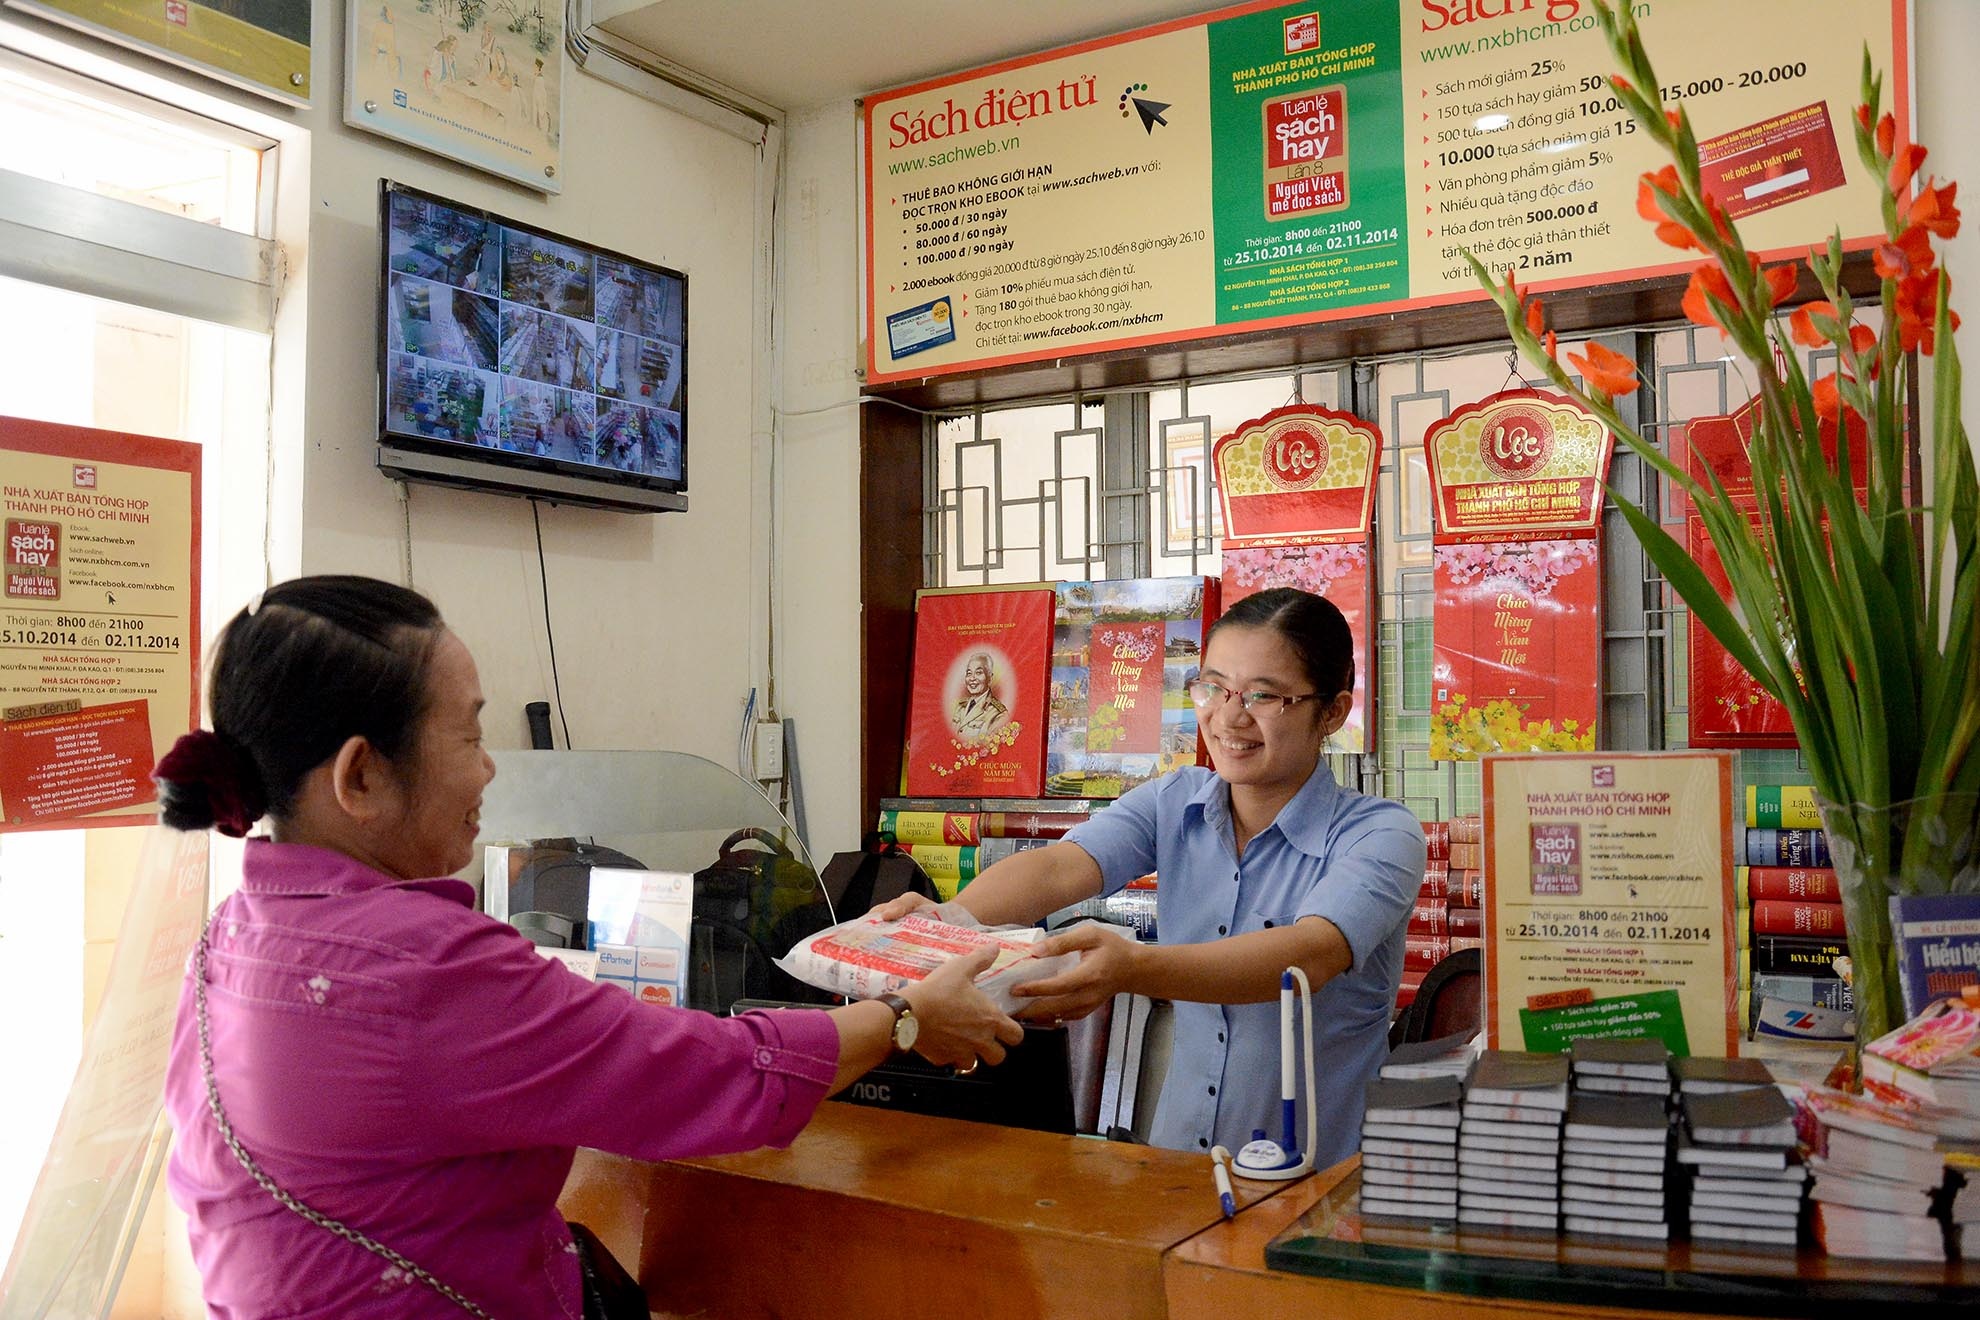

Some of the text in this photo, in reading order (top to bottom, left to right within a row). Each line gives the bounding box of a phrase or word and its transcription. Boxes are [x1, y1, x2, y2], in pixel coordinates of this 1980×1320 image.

[1420, 3, 1651, 64] www.nxbhcm.con
[1233, 42, 1376, 81] NHÀ XUẤT BẢN TỔNG HỢP
[1234, 56, 1375, 94] THÀNH PHỐ HỒ CHÍ MINH
[1436, 61, 1566, 96] Sách mới giảm 25%
[1659, 62, 1807, 102] 15.000 20.000
[889, 74, 1098, 150] Sách điện tử
[1276, 110, 1335, 141] sách
[888, 137, 1019, 175] www.sachweb.vn
[1282, 138, 1329, 160] hay
[1439, 152, 1613, 191] Văn phòng phẩm giảm 5%
[902, 164, 1052, 204] THUÊ BAO KHÔNG GIỚI HẠN
[902, 160, 1161, 221] ĐỌC TRỌN KHO EBOOK tại www.sachweb.vn với:
[1275, 176, 1337, 201] Người Việt
[1272, 189, 1342, 213] mê đọc sách
[1440, 179, 1593, 213] Nhiều quà tặng độc đáo
[1441, 201, 1598, 236] Hóa đơn trên 500.000 đ
[1245, 220, 1362, 248] Thời gian: 8h00 đến 21h00
[1223, 228, 1398, 266] từ 25.10.2014 đến 02.11.2014
[975, 263, 1135, 299] Giảm 10% phiếu mua sách điện tử.
[976, 313, 1163, 348] Chi tiết tại: www.facebook.com/nxbhcm
[1495, 427, 1540, 463] Lộc
[1276, 441, 1317, 475] Lộc
[4, 486, 149, 511] NHÀ XUẤT BẢN TỔNG HỢP
[1478, 484, 1504, 498] XUẤT
[1529, 483, 1557, 495] TỔNG
[1559, 482, 1580, 495] HỢP
[4, 500, 149, 523] THÀNH PHỐ HỒ CHÍ MINH
[1457, 501, 1490, 513] THÀNH
[1491, 499, 1514, 512] PHỐ
[1551, 496, 1581, 510] MINH
[12, 534, 54, 551] sách
[69, 534, 135, 545] www.sachweb.vn
[15, 549, 49, 567] hay
[69, 557, 150, 568] www.nxbhcm.com.vn
[69, 579, 175, 591] www.facebook.com/nxbhcm
[1496, 594, 1528, 610] Chúc
[6, 616, 144, 630] Thời gian: 8h00 đến 21h00
[1494, 611, 1533, 632] Mừng
[0, 630, 180, 649] 5.10.2014 đến 02.11.2014
[1496, 630, 1528, 646] Năm
[1501, 649, 1526, 667] Mới
[1527, 792, 1670, 804] NHÀ XUẤT BẢN TỔNG HỢP
[1528, 805, 1671, 816] THÀNH PHỐ HỒ CHÍ MINH
[956, 817, 967, 832] 2010
[1789, 830, 1802, 844] Việ
[1531, 910, 1668, 923] Thời gian: 8h00 đến 21h00
[1506, 924, 1711, 940] từ 25.10.2014 đến 02.11.2014
[852, 1082, 891, 1102] AOC
